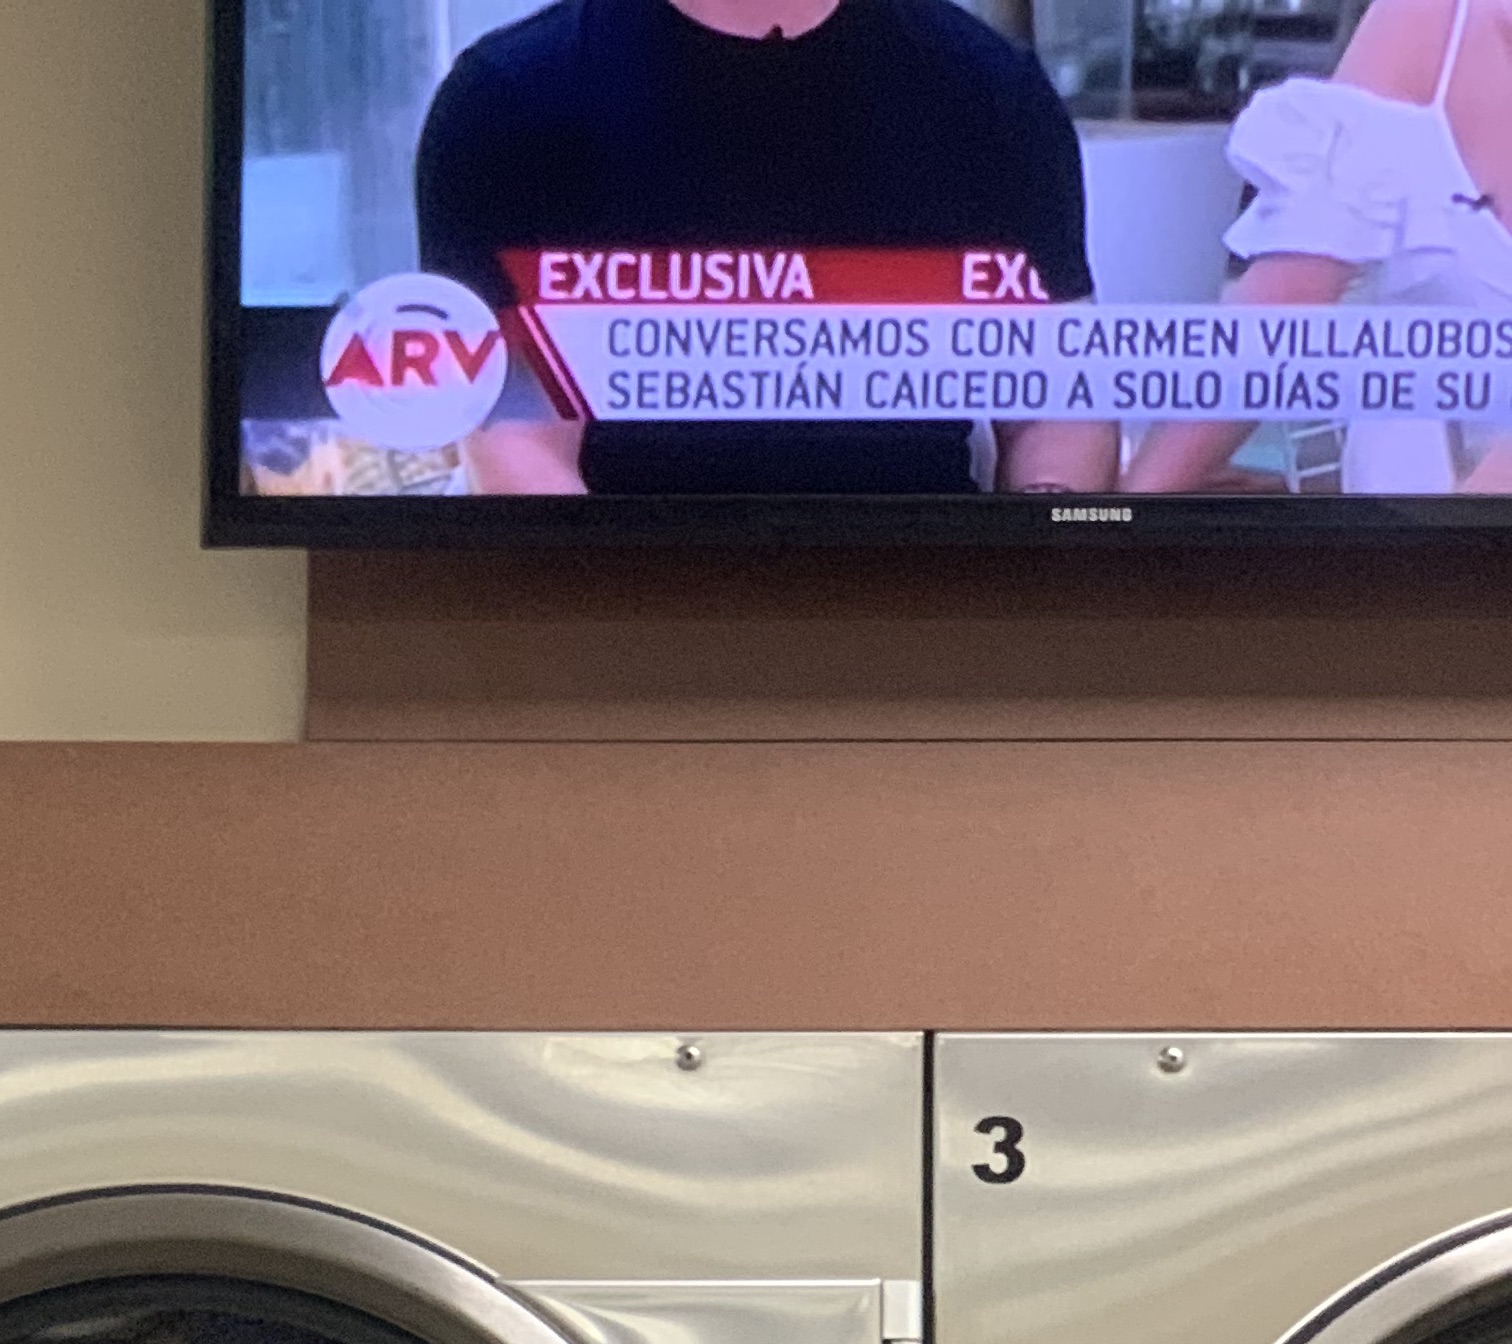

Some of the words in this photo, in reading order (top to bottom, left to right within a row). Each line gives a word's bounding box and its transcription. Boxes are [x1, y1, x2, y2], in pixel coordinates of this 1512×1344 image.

[538, 252, 815, 299] EXCLUSIVA
[323, 329, 502, 388] ARV
[608, 318, 930, 358] CONVERSAMOS
[951, 318, 1035, 358] CON
[1057, 318, 1239, 358] CARMEN
[1258, 318, 1512, 359] VILLALOBOS
[607, 361, 843, 409] SEBASTIÁN
[865, 370, 1049, 409] CAICEDO
[1066, 370, 1094, 409] A
[1113, 370, 1222, 410] SOLO
[1243, 361, 1340, 410] DÍAS
[1361, 370, 1417, 410] DE
[1435, 370, 1491, 411] SU
[1051, 507, 1133, 522] SAMSUNG
[971, 1116, 1026, 1184] 3
